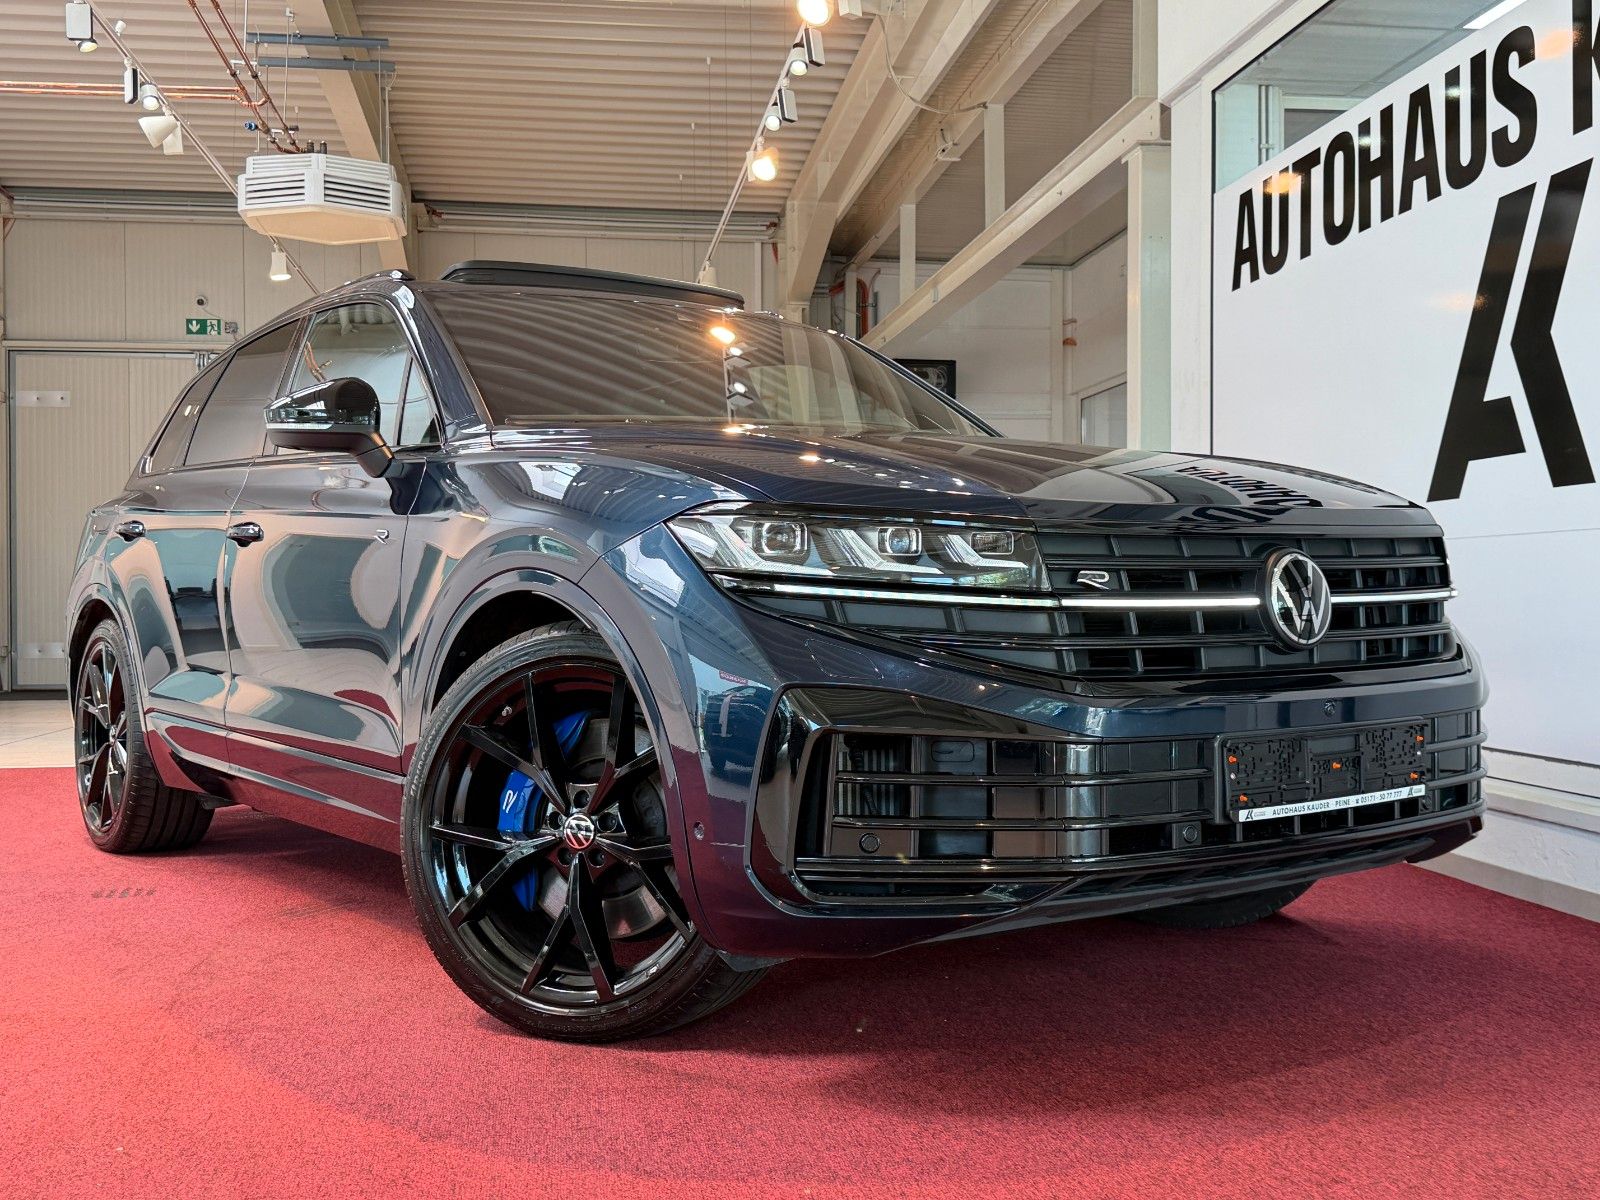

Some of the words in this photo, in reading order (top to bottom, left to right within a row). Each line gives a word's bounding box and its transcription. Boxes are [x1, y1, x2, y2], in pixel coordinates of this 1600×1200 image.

[1231, 25, 1538, 292] AUTOHAUS
[373, 529, 390, 545] R
[1076, 570, 1110, 590] R
[1272, 805, 1306, 816] AUTOHAUS
[1306, 801, 1330, 811] KAUDER
[1335, 799, 1351, 807] PEINE
